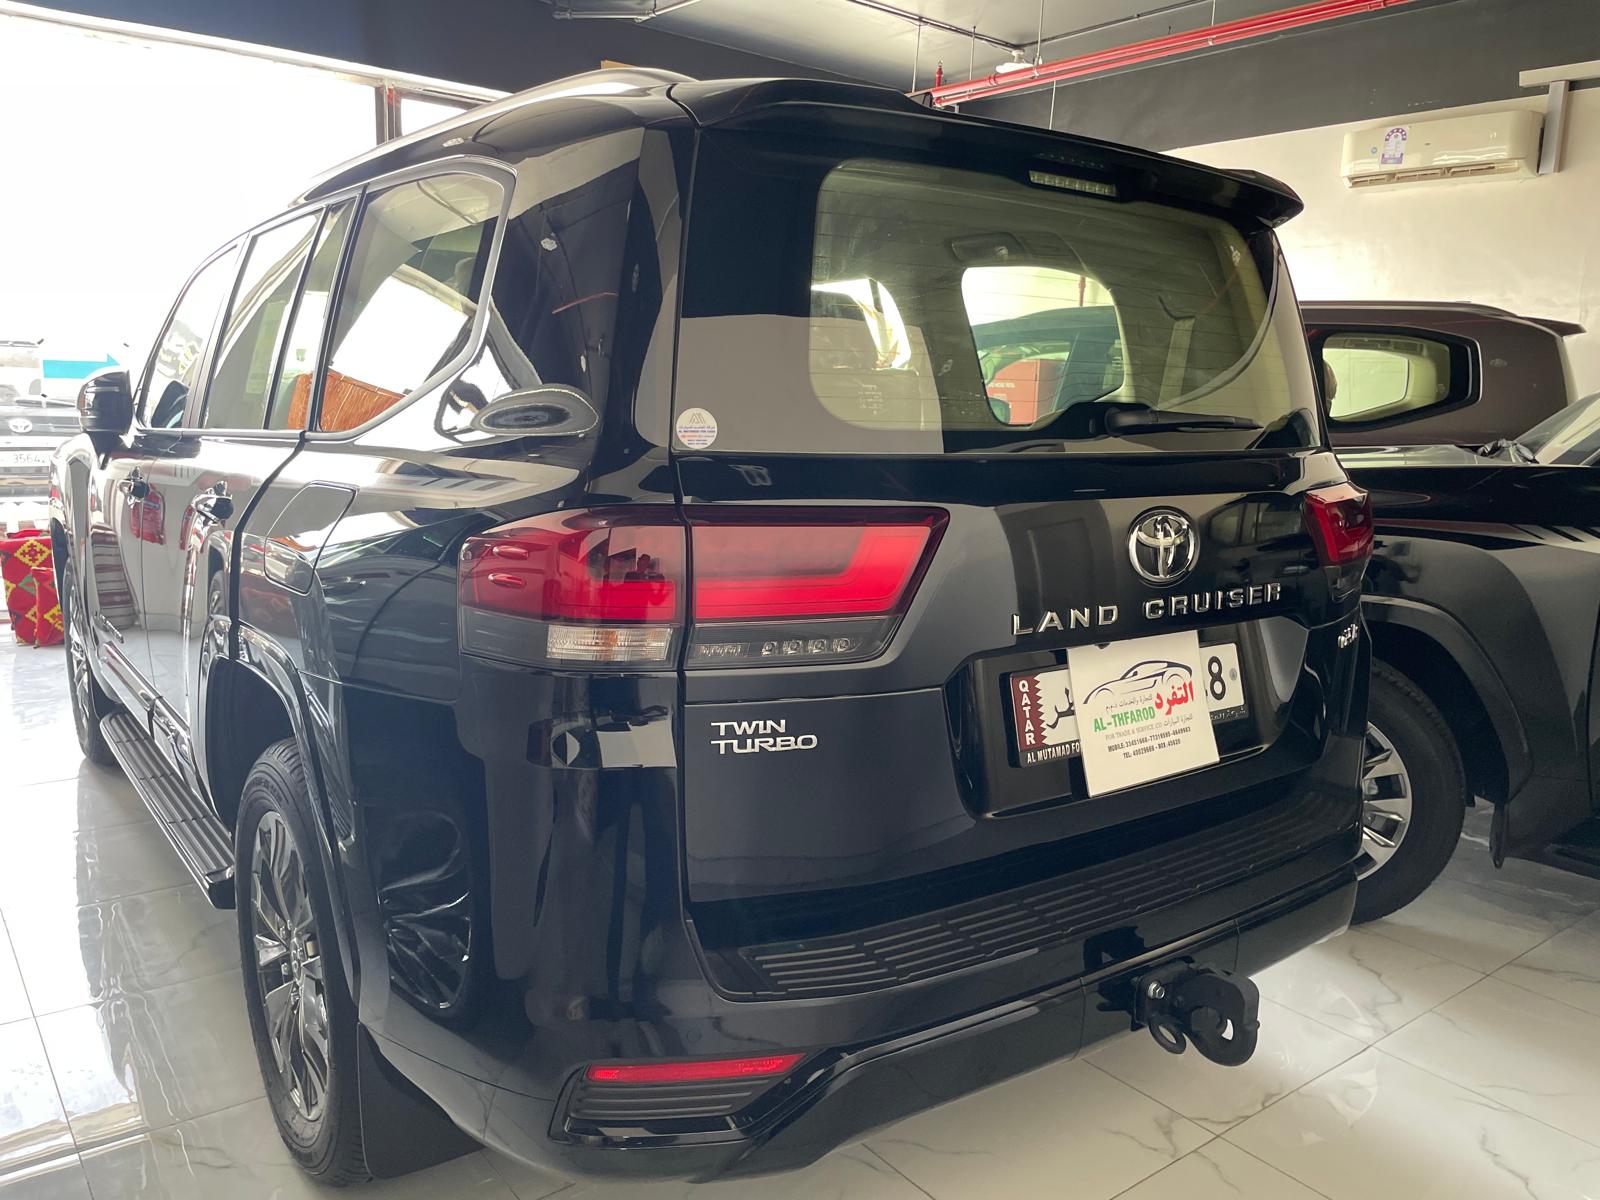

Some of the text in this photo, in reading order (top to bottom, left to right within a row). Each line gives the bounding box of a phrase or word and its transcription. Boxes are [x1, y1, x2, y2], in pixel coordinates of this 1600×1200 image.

[1012, 582, 1281, 635] LAND CRUISER
[1155, 680, 1194, 715] التفرد
[1019, 680, 1036, 745] QATAR
[1094, 706, 1156, 732] AL-THFAROD
[711, 719, 785, 736] TWIN
[711, 734, 818, 754] TURBO
[1027, 742, 1080, 764] AL MUTAMAD FO
